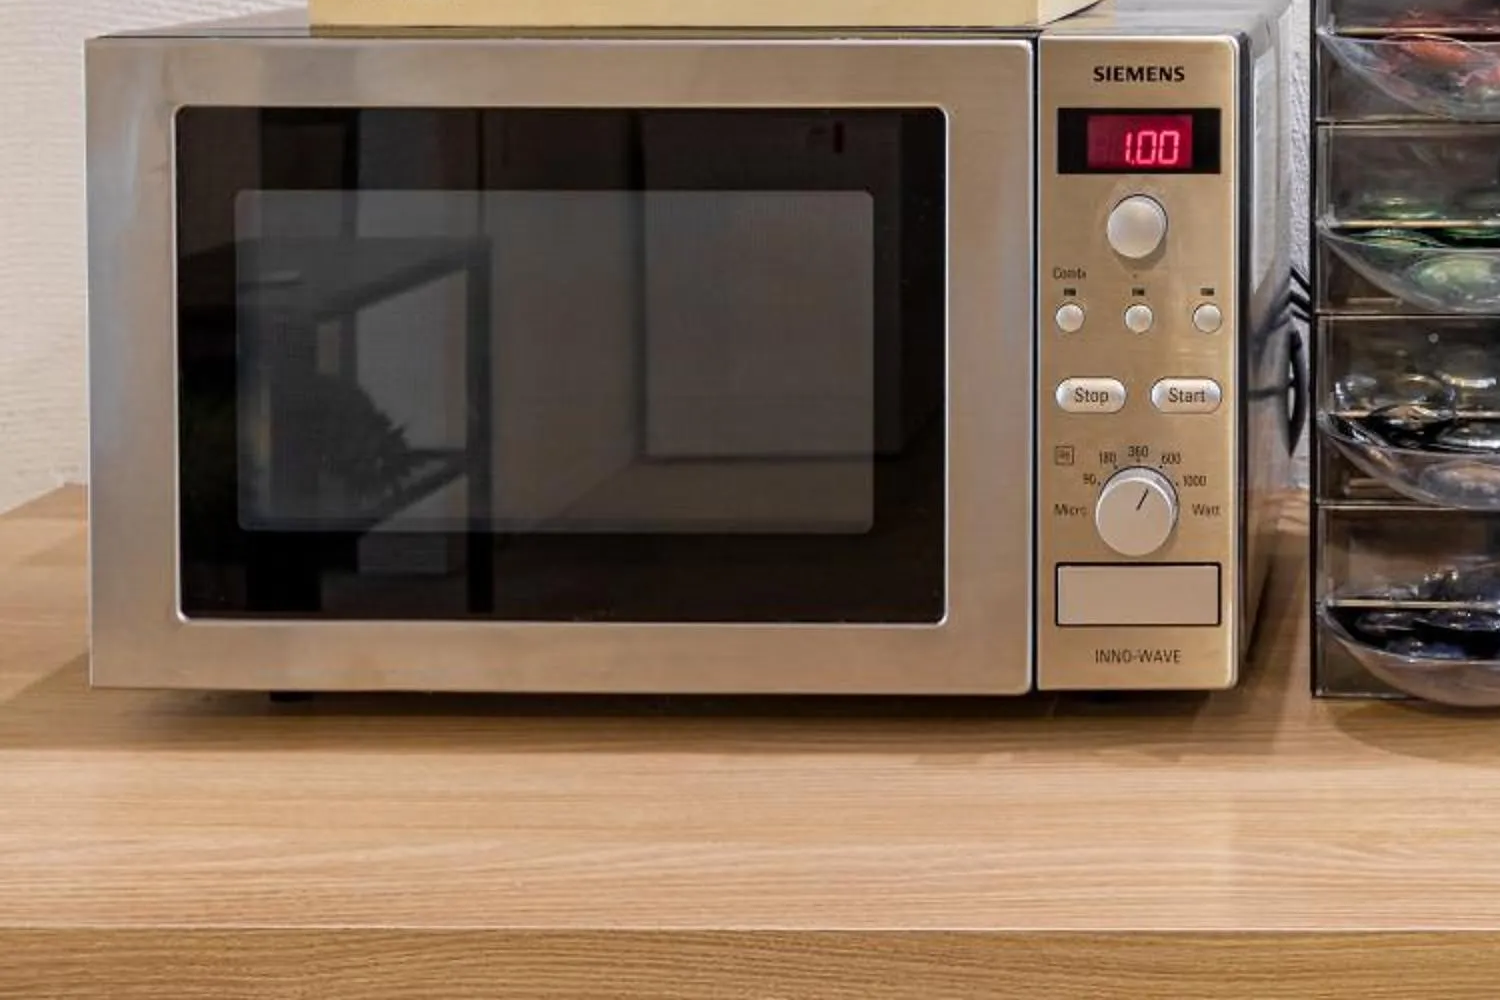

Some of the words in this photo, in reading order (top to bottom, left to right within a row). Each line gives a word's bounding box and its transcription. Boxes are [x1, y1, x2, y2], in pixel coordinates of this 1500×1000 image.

[1093, 66, 1185, 83] SIEMENS
[1073, 386, 1110, 406] Stop
[1168, 386, 1206, 403] Start
[1127, 446, 1149, 458] 360
[1161, 453, 1181, 464] 600
[1183, 475, 1207, 487] 1000
[1054, 503, 1087, 516] Micro
[1192, 503, 1221, 516] Watt
[1095, 649, 1182, 664] INNO-WAVE
